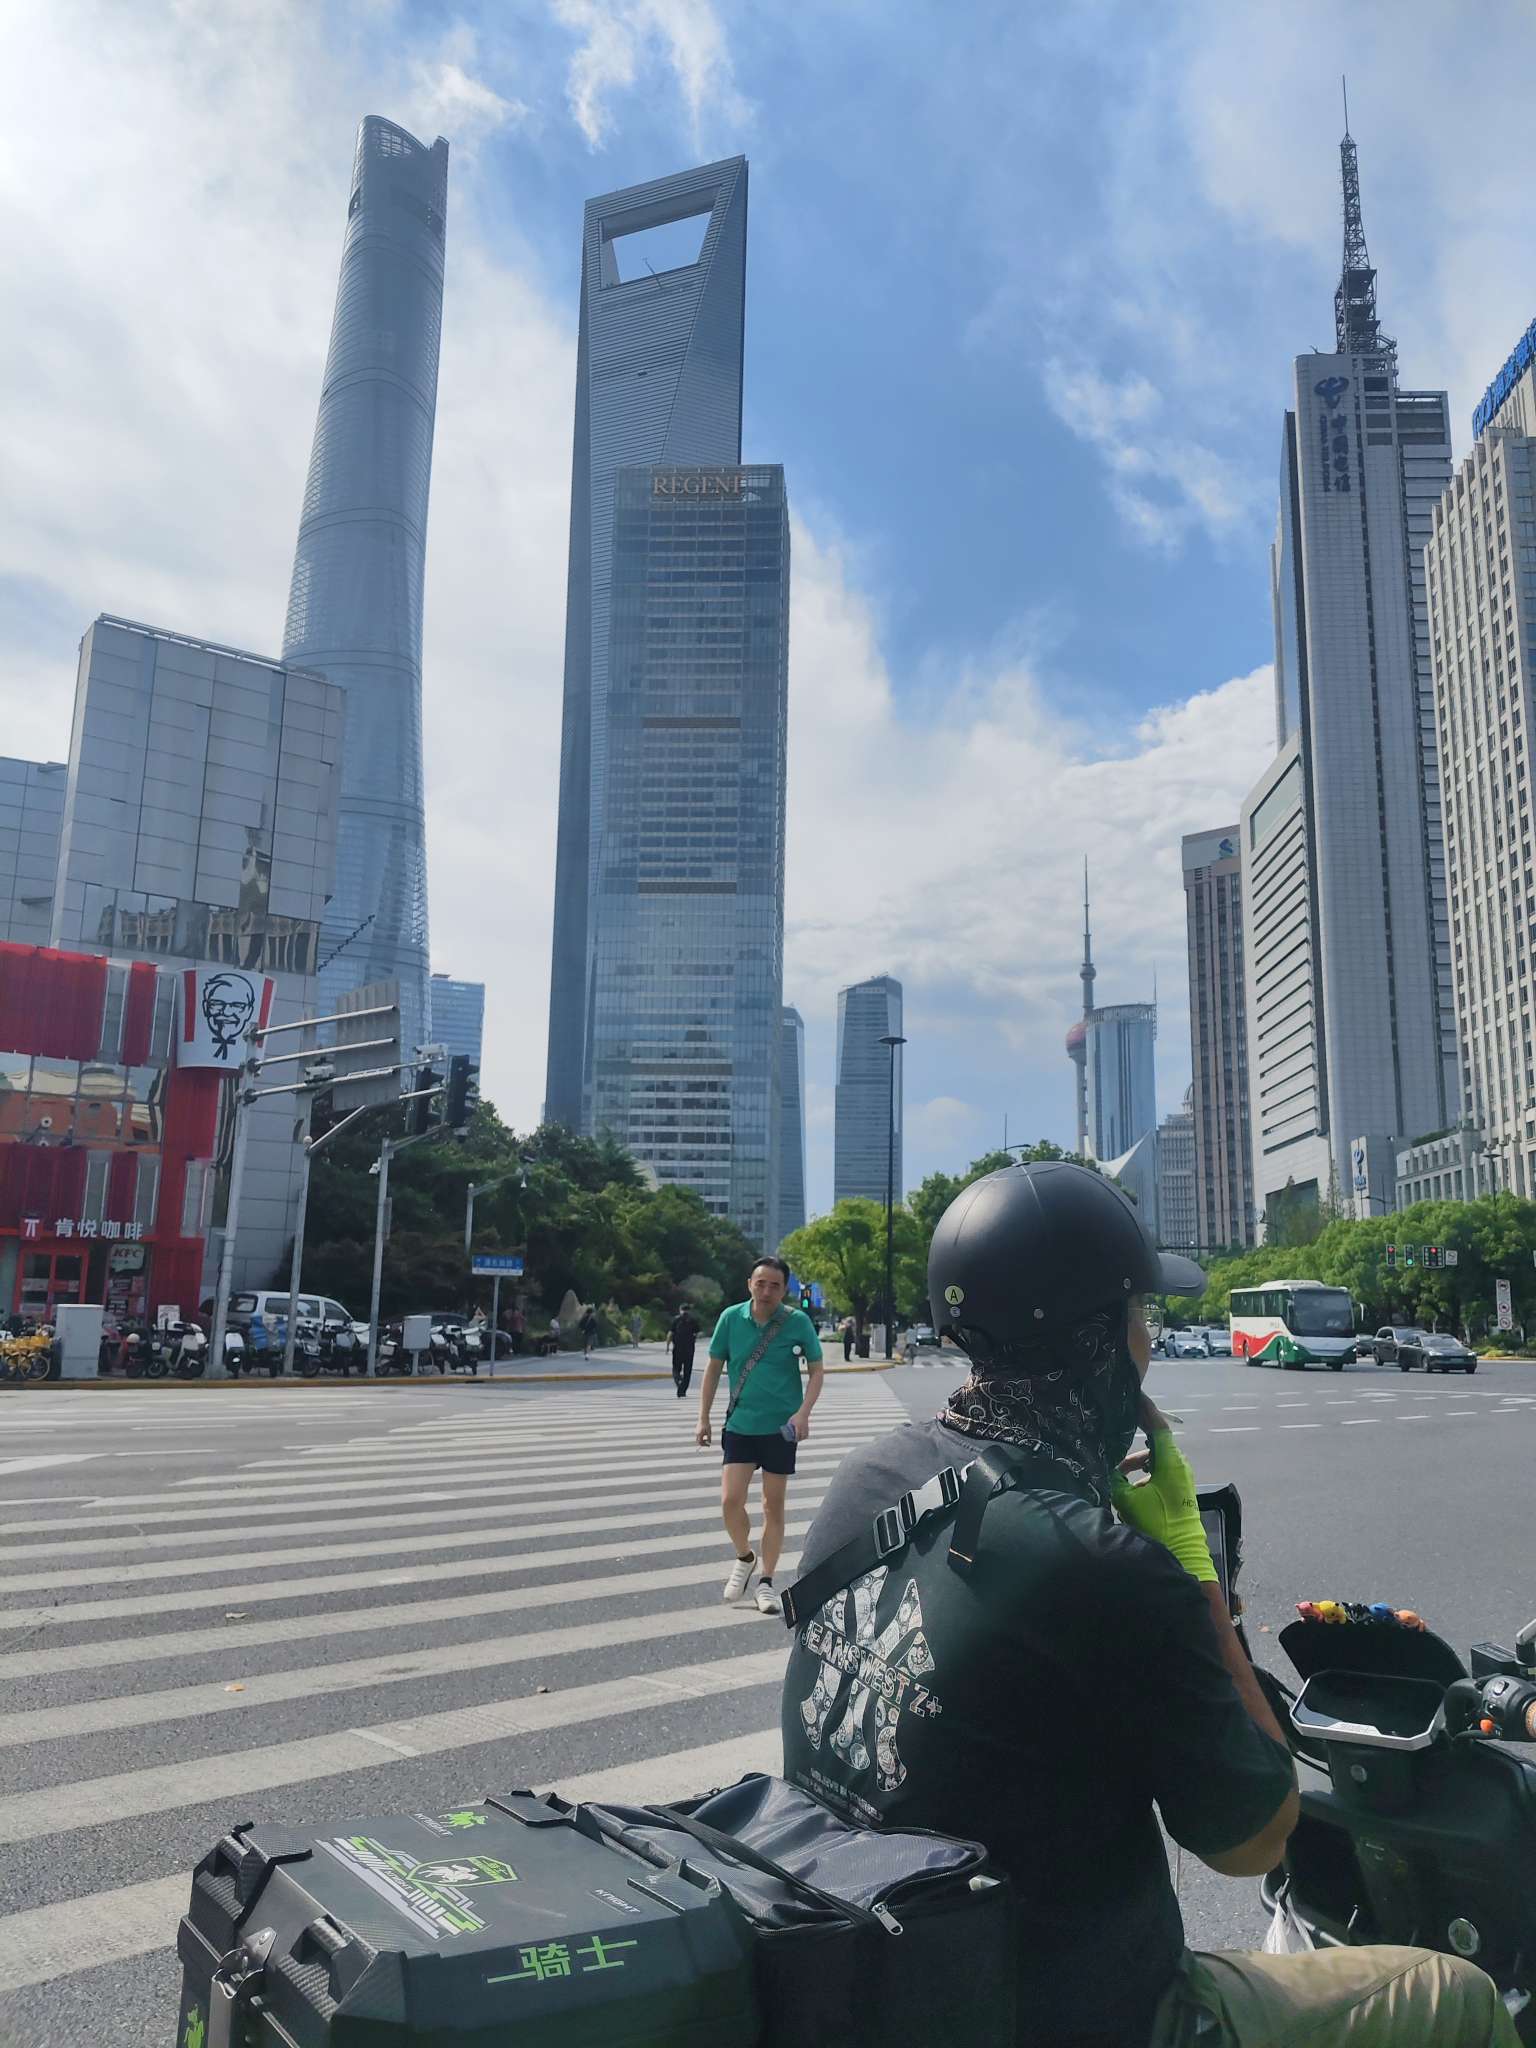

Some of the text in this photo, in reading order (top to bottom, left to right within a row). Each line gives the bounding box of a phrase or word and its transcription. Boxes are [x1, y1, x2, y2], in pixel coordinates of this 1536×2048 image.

[653, 475, 742, 495] REGENT
[54, 1217, 144, 1241] 肯悦咖啡
[113, 1247, 142, 1258] KFC
[950, 1288, 959, 1302] A
[487, 1935, 638, 1984] 骑士
